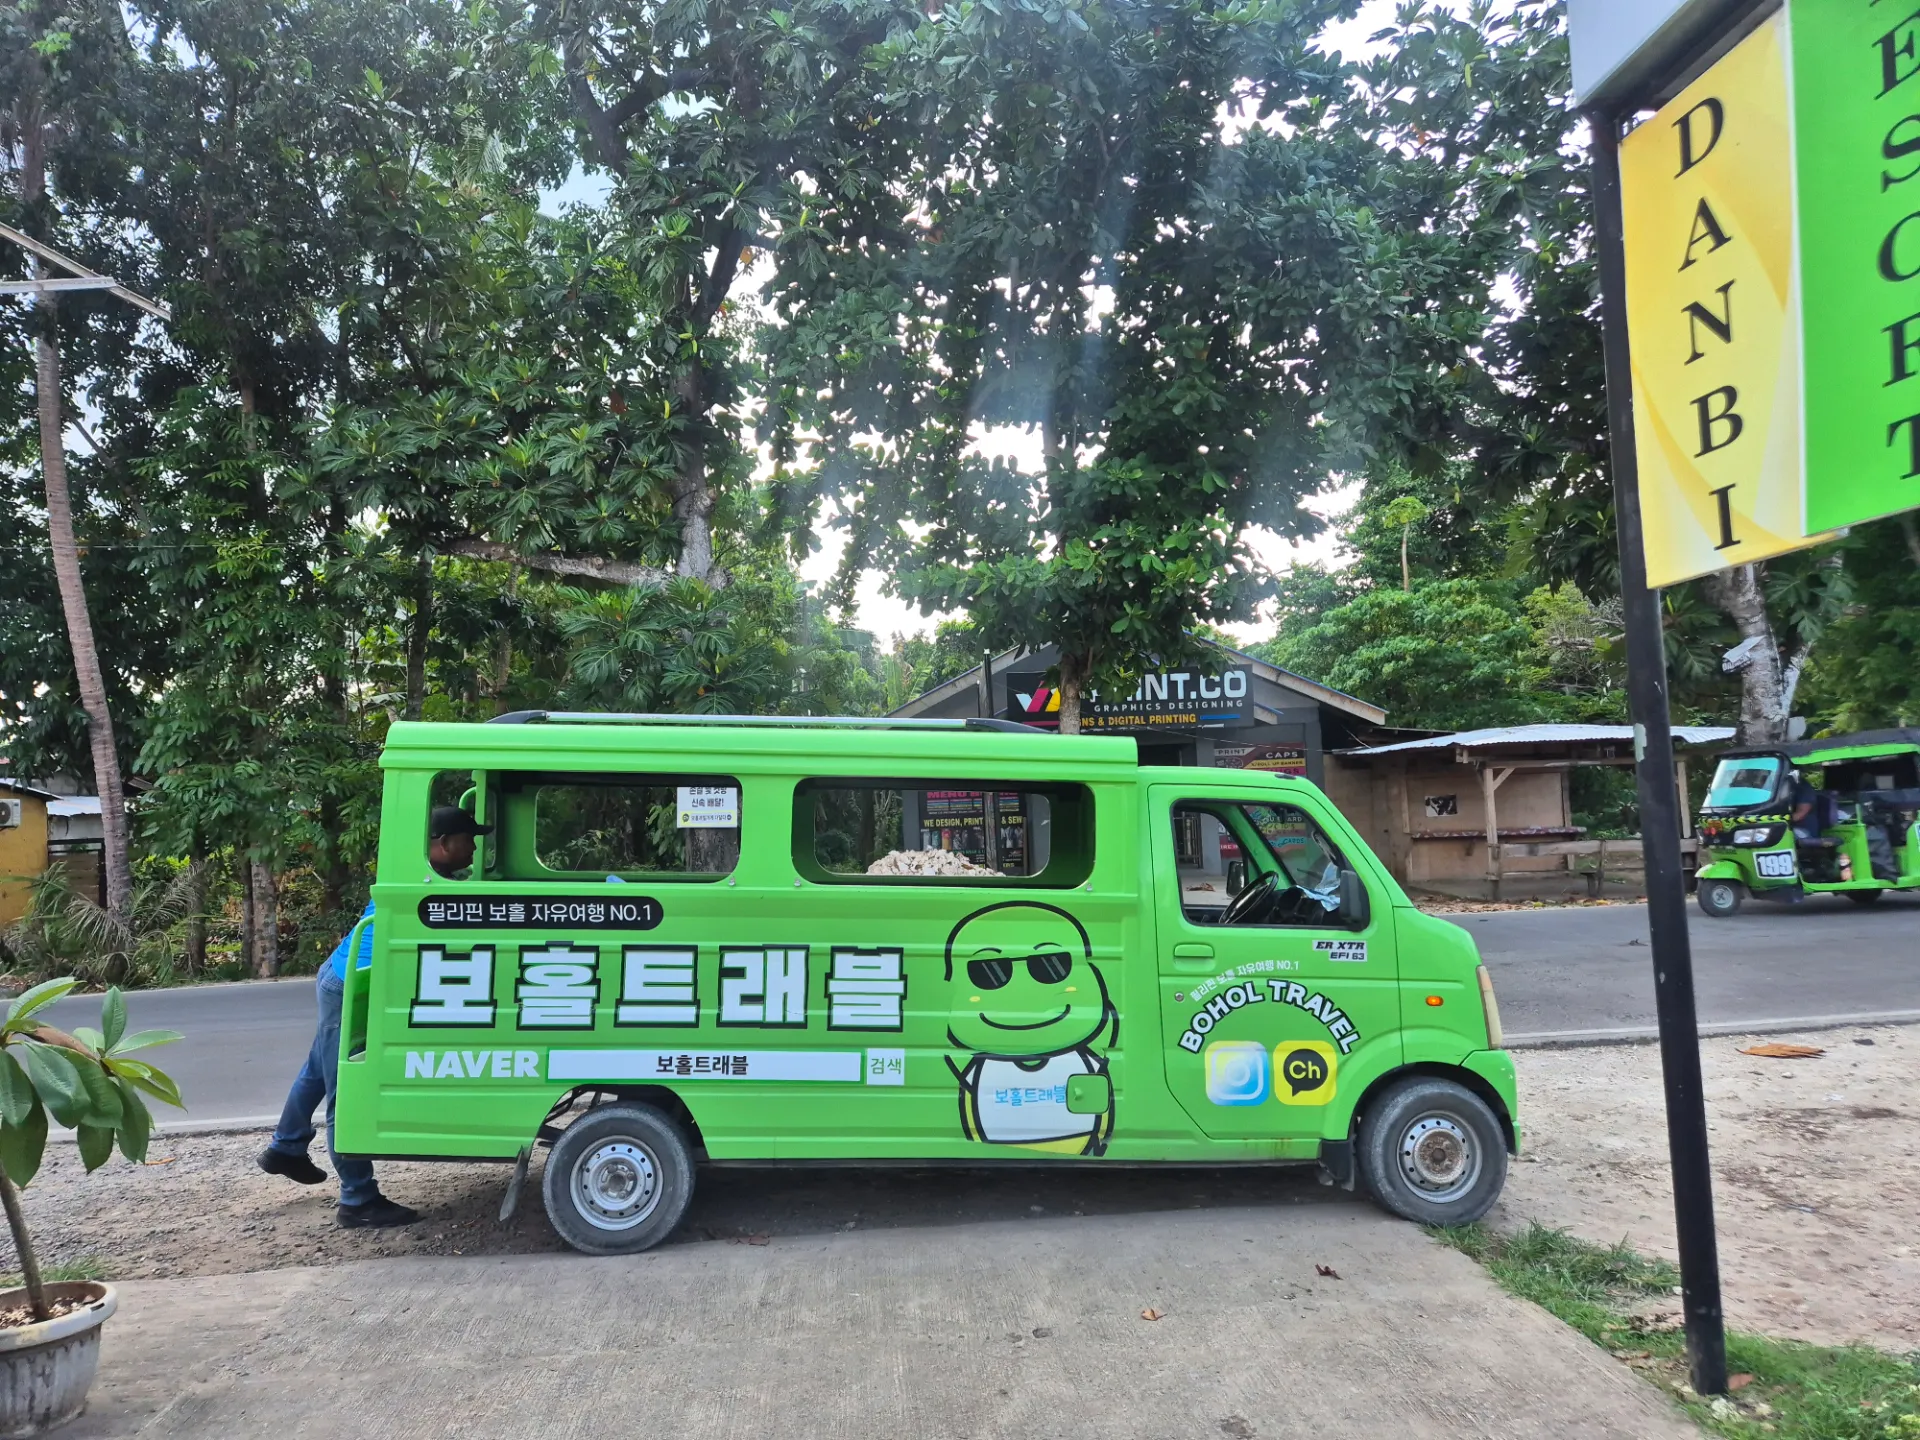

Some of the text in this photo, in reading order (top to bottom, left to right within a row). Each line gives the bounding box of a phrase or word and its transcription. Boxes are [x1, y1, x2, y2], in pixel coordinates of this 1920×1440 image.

[1869, 0, 1920, 480] ESORT
[1671, 96, 1744, 552] DANBI
[1094, 699, 1243, 712] GRAPHICS DESIGNING
[1098, 716, 1105, 726] &
[1108, 715, 1146, 726] DIGITAL
[1150, 713, 1197, 724] PRINTING
[1265, 751, 1298, 759] CAPS
[924, 819, 935, 828] WE
[936, 818, 963, 828] DESIGN,
[964, 816, 984, 826] PRINT
[1757, 854, 1793, 877] 199
[427, 902, 651, 923] 필리핀 보홀 자유여행 NO.1
[1330, 951, 1350, 960] EFI
[1336, 941, 1366, 950] XTR
[1236, 959, 1275, 977] 자유여행
[1276, 960, 1300, 972] NO.1
[408, 941, 908, 1032] 보홀트래블
[1178, 978, 1361, 1056] BOHOL TRAVEL
[404, 1050, 540, 1079] NAVER
[656, 1054, 750, 1076] 보홀트래블
[869, 1056, 904, 1076] 검색
[1289, 1060, 1321, 1079] Ch
[994, 1084, 1067, 1107] 보홀트래블
